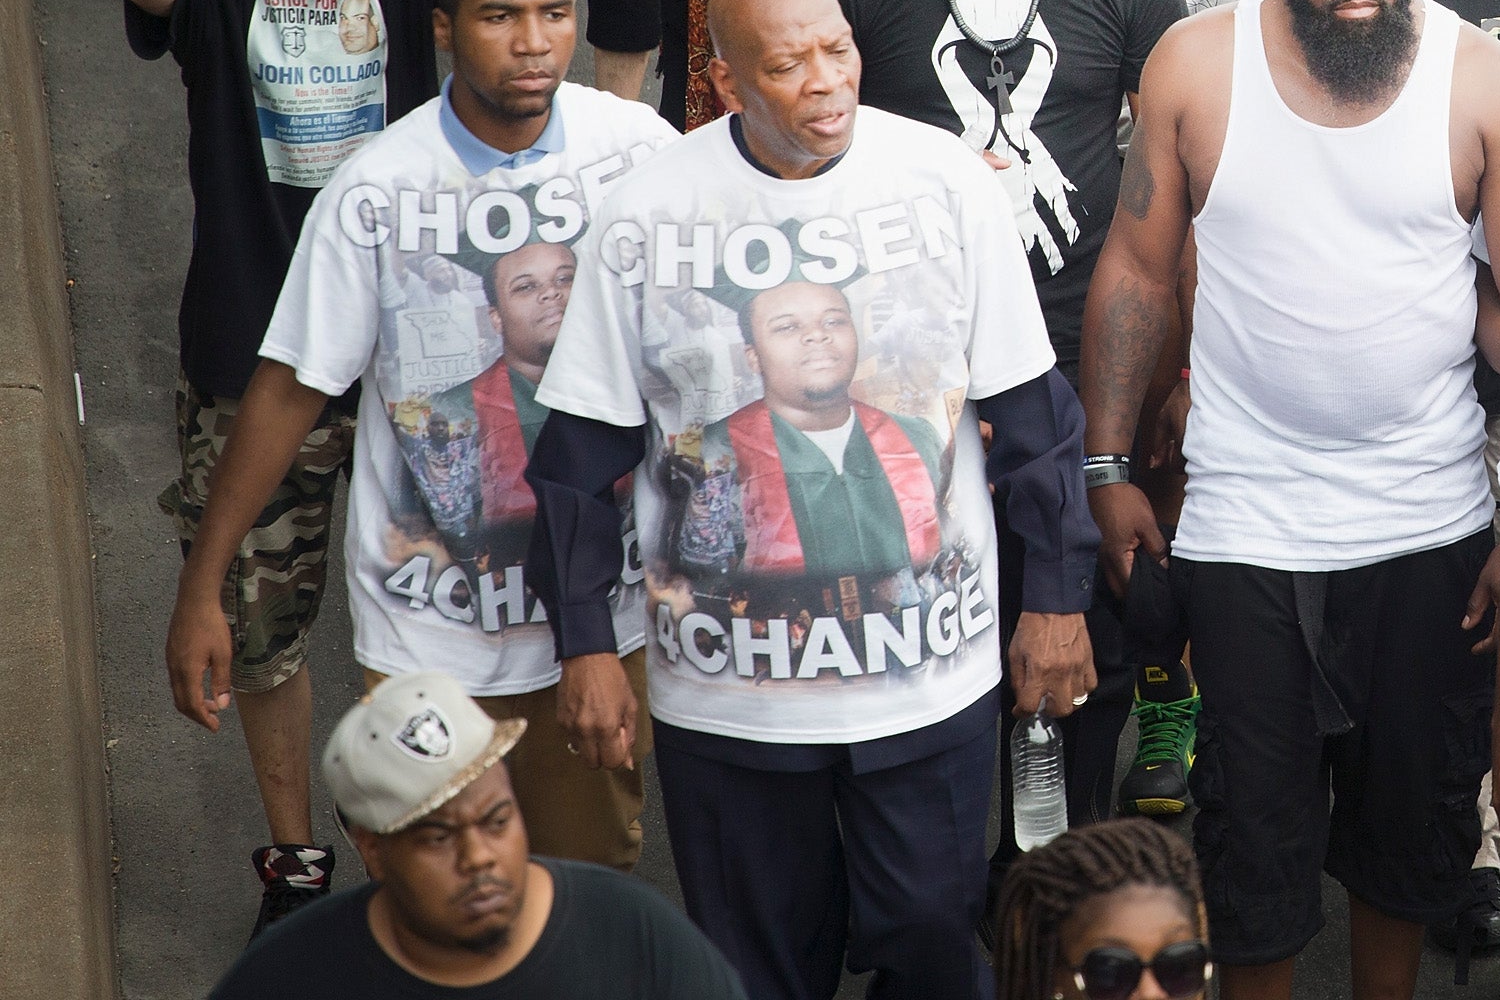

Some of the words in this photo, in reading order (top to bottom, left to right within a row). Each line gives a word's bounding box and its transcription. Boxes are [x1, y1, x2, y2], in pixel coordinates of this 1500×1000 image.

[308, 12, 338, 26] PARA
[255, 63, 303, 85] JOHN
[309, 59, 382, 85] COLLADO
[339, 142, 658, 254] CHOSE
[600, 192, 965, 290] CHOSEN
[404, 355, 480, 379] JUSTICE
[384, 555, 549, 632] 4CH
[656, 569, 995, 679] 4CHANGE
